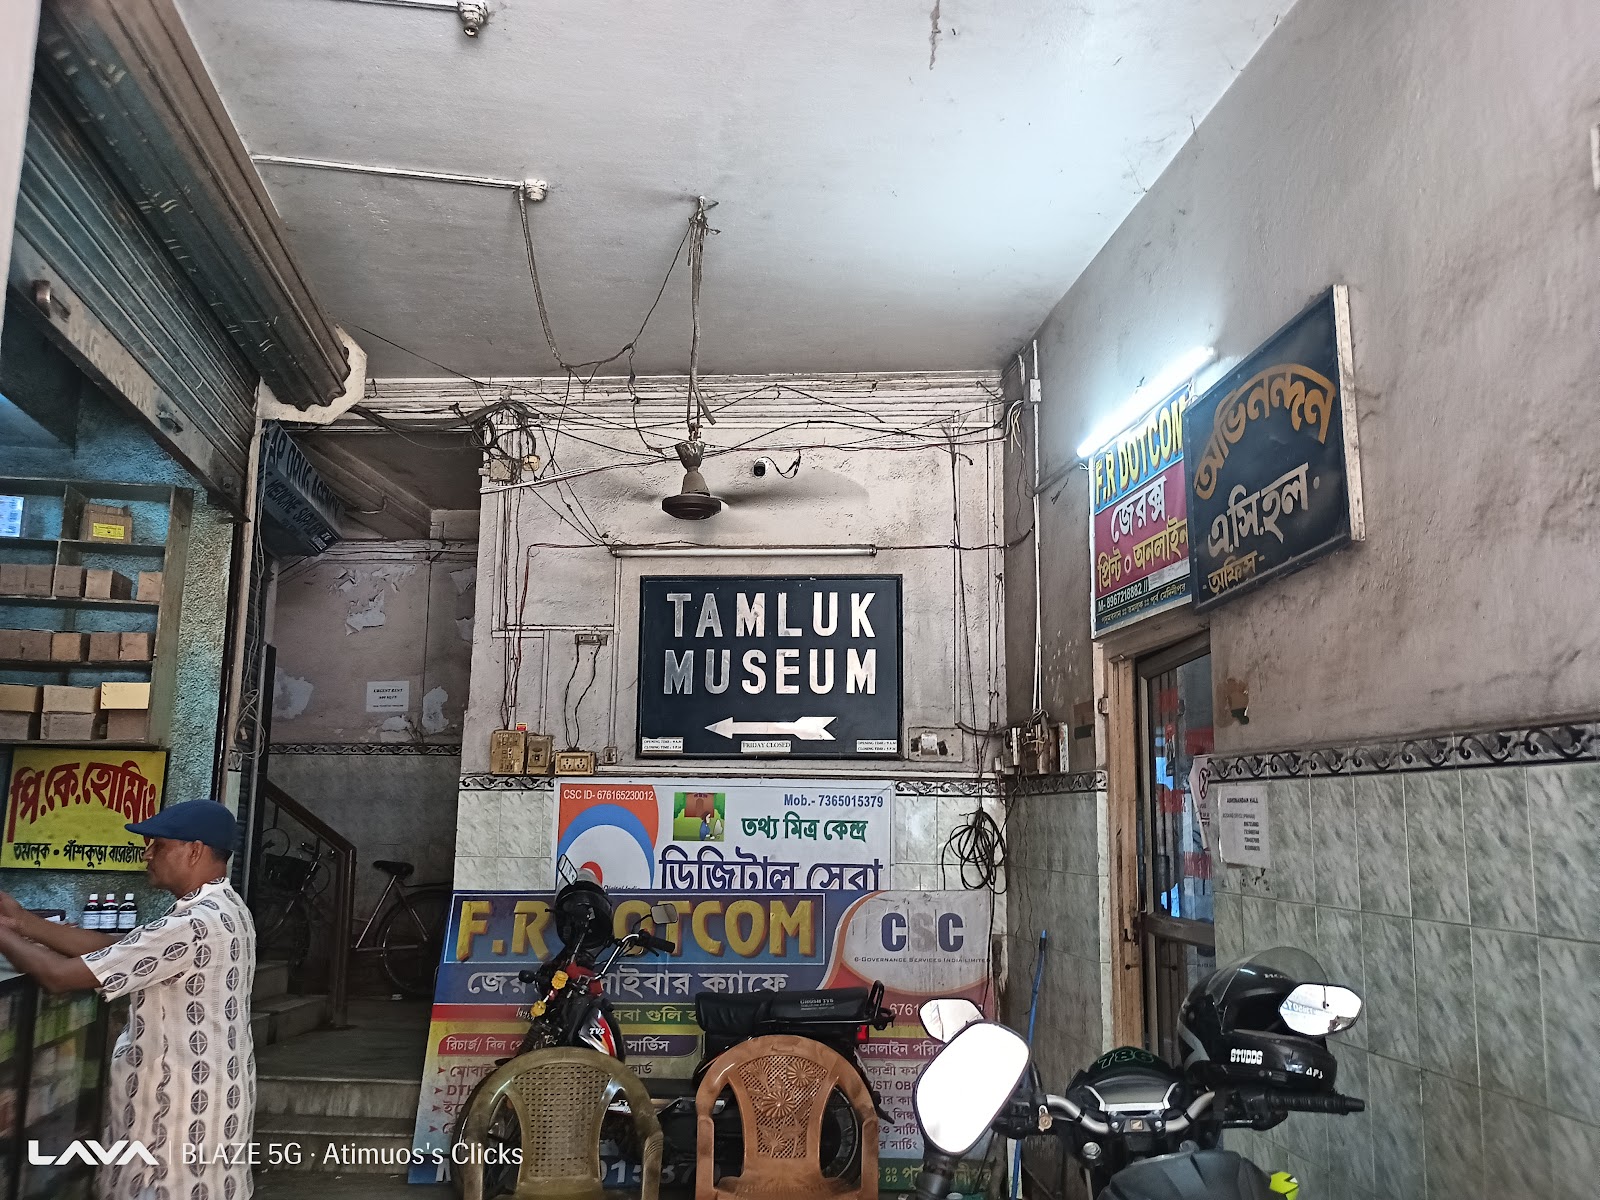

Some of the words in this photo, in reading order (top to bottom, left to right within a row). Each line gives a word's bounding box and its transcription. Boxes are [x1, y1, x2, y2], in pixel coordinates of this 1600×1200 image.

[1193, 363, 1336, 500] অভিনন্দন
[1110, 475, 1167, 543] জেরক্স
[1132, 515, 1189, 570] অনলাইন
[666, 592, 876, 638] TAMLUK
[663, 648, 877, 695] MUSEUM
[563, 789, 582, 799] CSC
[597, 790, 654, 800] 676165230012
[818, 795, 884, 808] 7365015379
[741, 815, 780, 840] তথ্য
[782, 811, 820, 840] মিত্র
[824, 820, 868, 843] কেন্দ্র
[13, 843, 51, 867] তমলুক
[659, 845, 799, 890] ডিজিটাল
[806, 859, 884, 890] সেবা
[456, 900, 549, 962] F.R
[612, 899, 816, 956] OTCOM
[589, 1027, 606, 1035] TVS
[626, 1036, 670, 1053] সার্ভিস
[860, 1040, 909, 1056] অনলাইন
[1230, 1048, 1263, 1065] STUDDS
